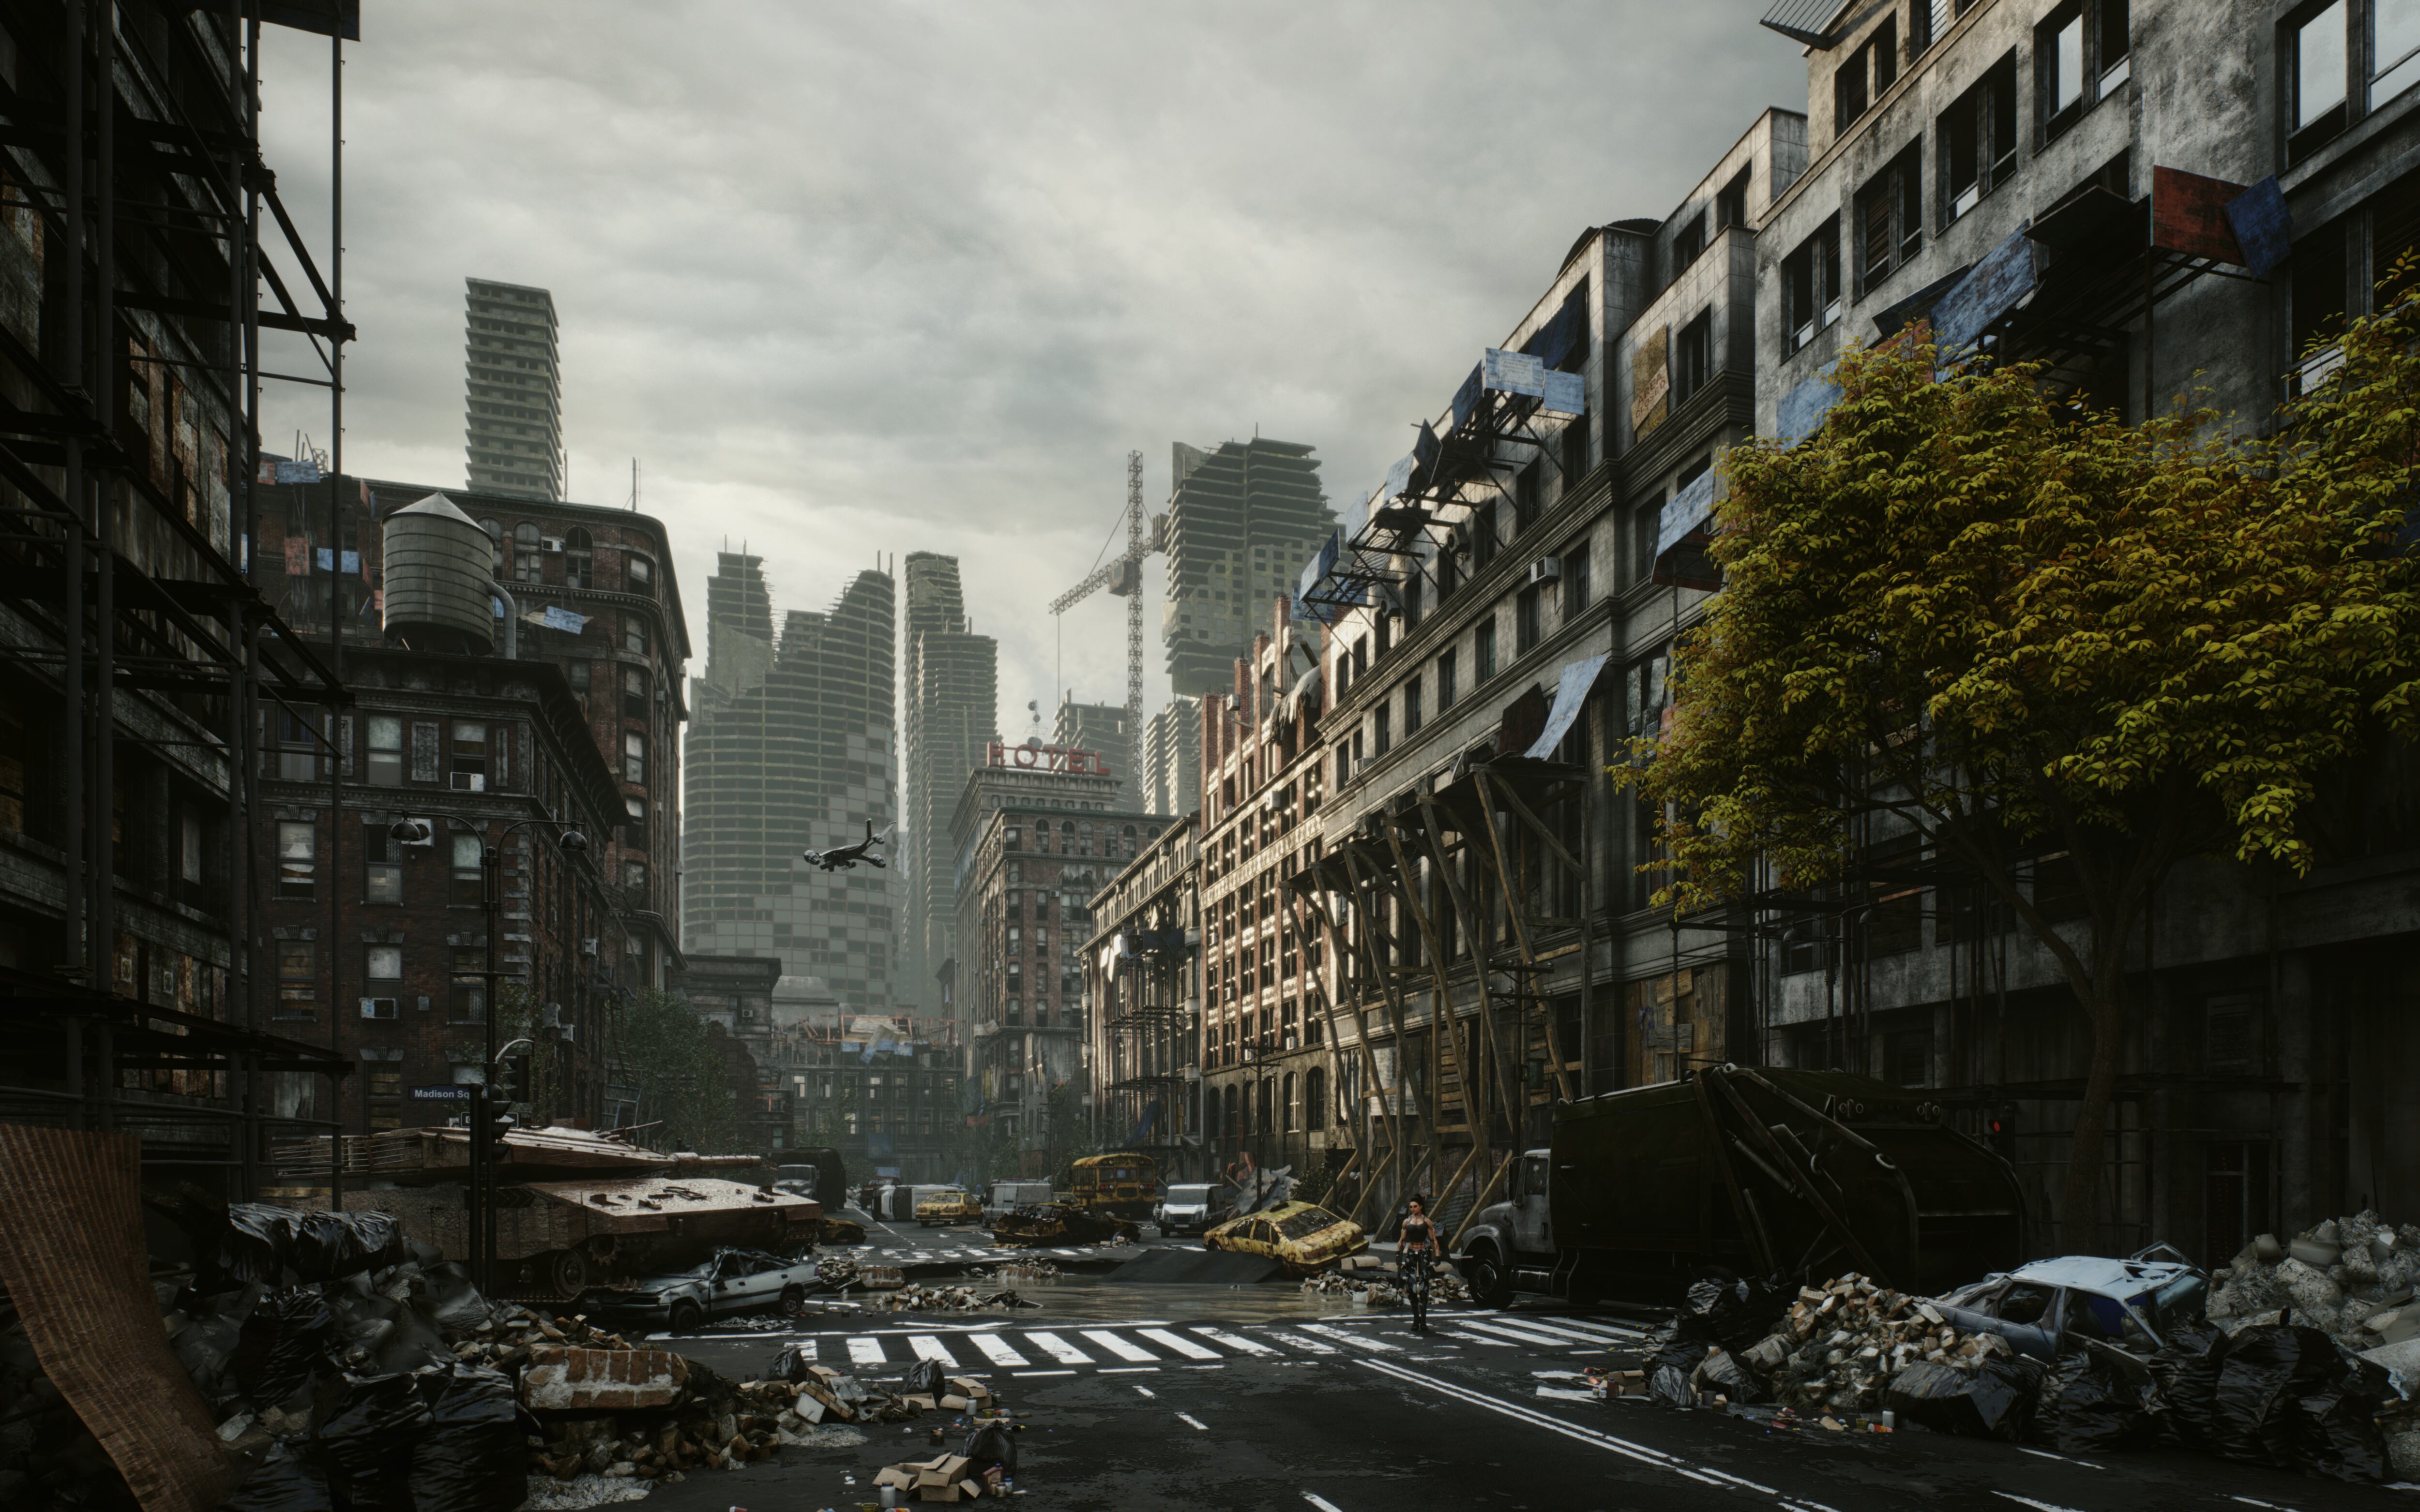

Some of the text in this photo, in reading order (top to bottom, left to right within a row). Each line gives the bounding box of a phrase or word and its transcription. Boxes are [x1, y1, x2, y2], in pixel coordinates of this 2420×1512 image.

[1636, 380, 1665, 419] CLOSED
[1638, 374, 1662, 405] AREA
[988, 741, 1111, 775] HOTEL
